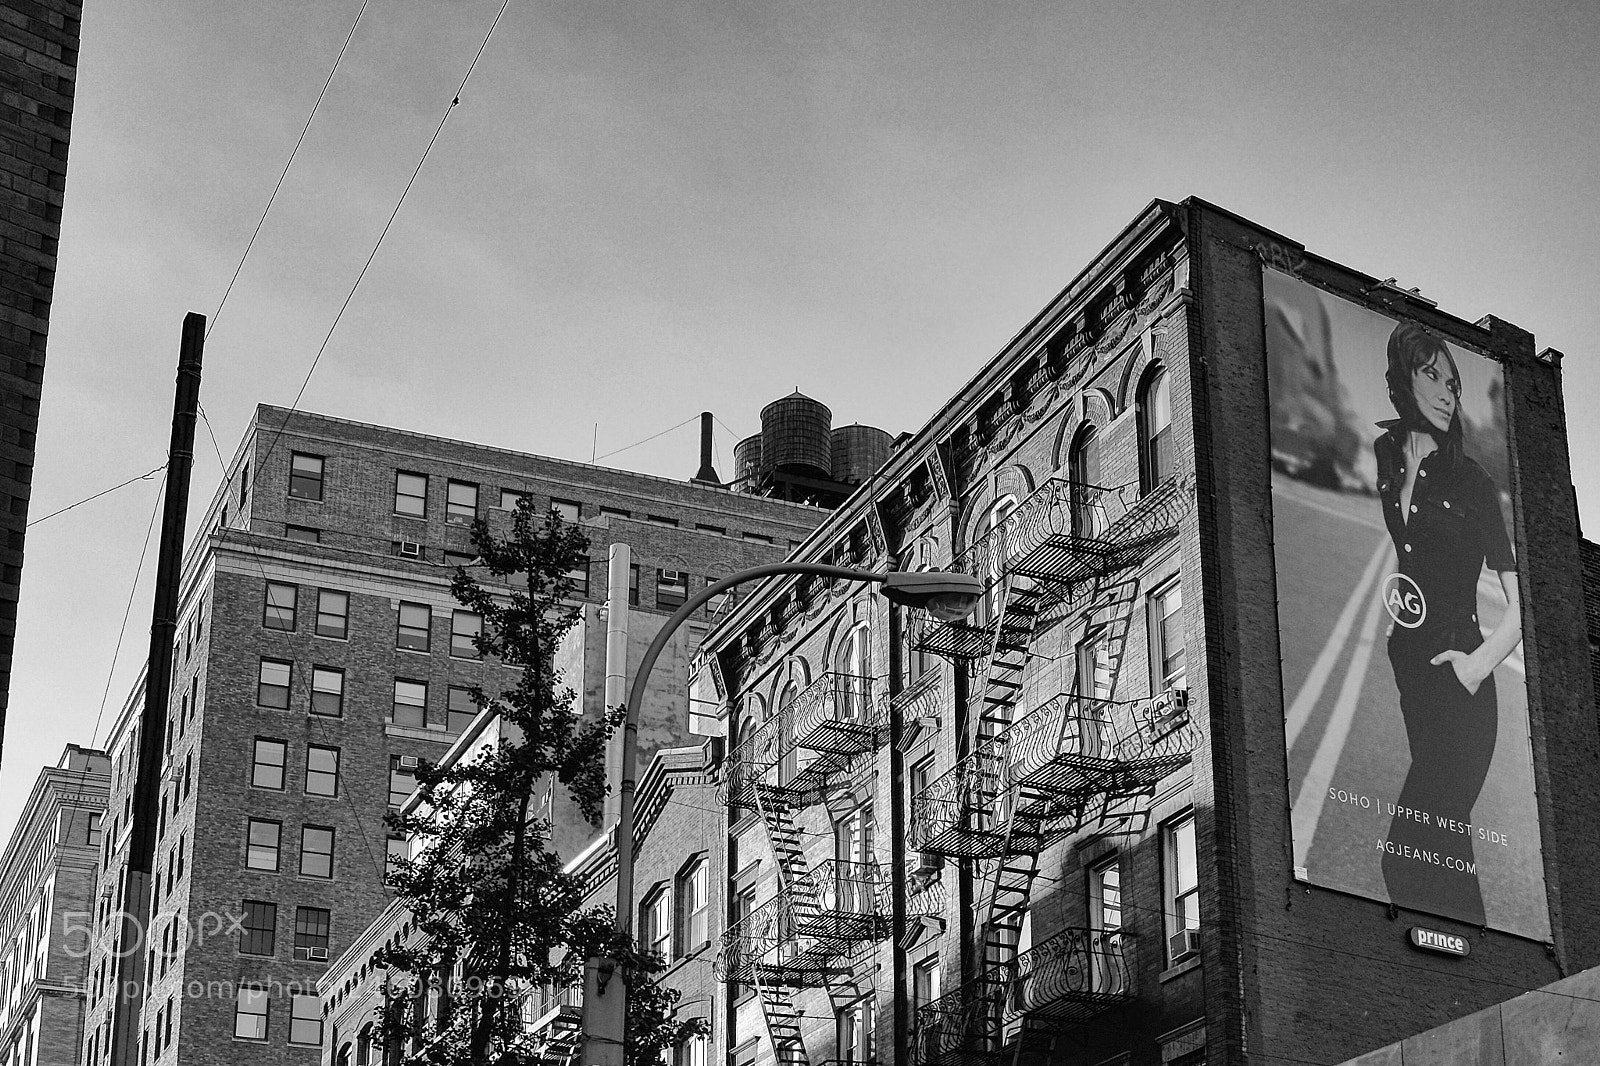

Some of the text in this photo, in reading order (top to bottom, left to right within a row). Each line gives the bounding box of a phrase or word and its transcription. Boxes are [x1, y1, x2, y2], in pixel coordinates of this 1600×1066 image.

[1389, 588, 1420, 615] AG
[1329, 787, 1370, 809] SOHO
[1387, 803, 1430, 825] UPPER
[1436, 815, 1473, 836] WEST
[1479, 827, 1508, 847] SIDE
[1376, 838, 1477, 875] AGJEANS.COM
[1417, 929, 1464, 951] prince
